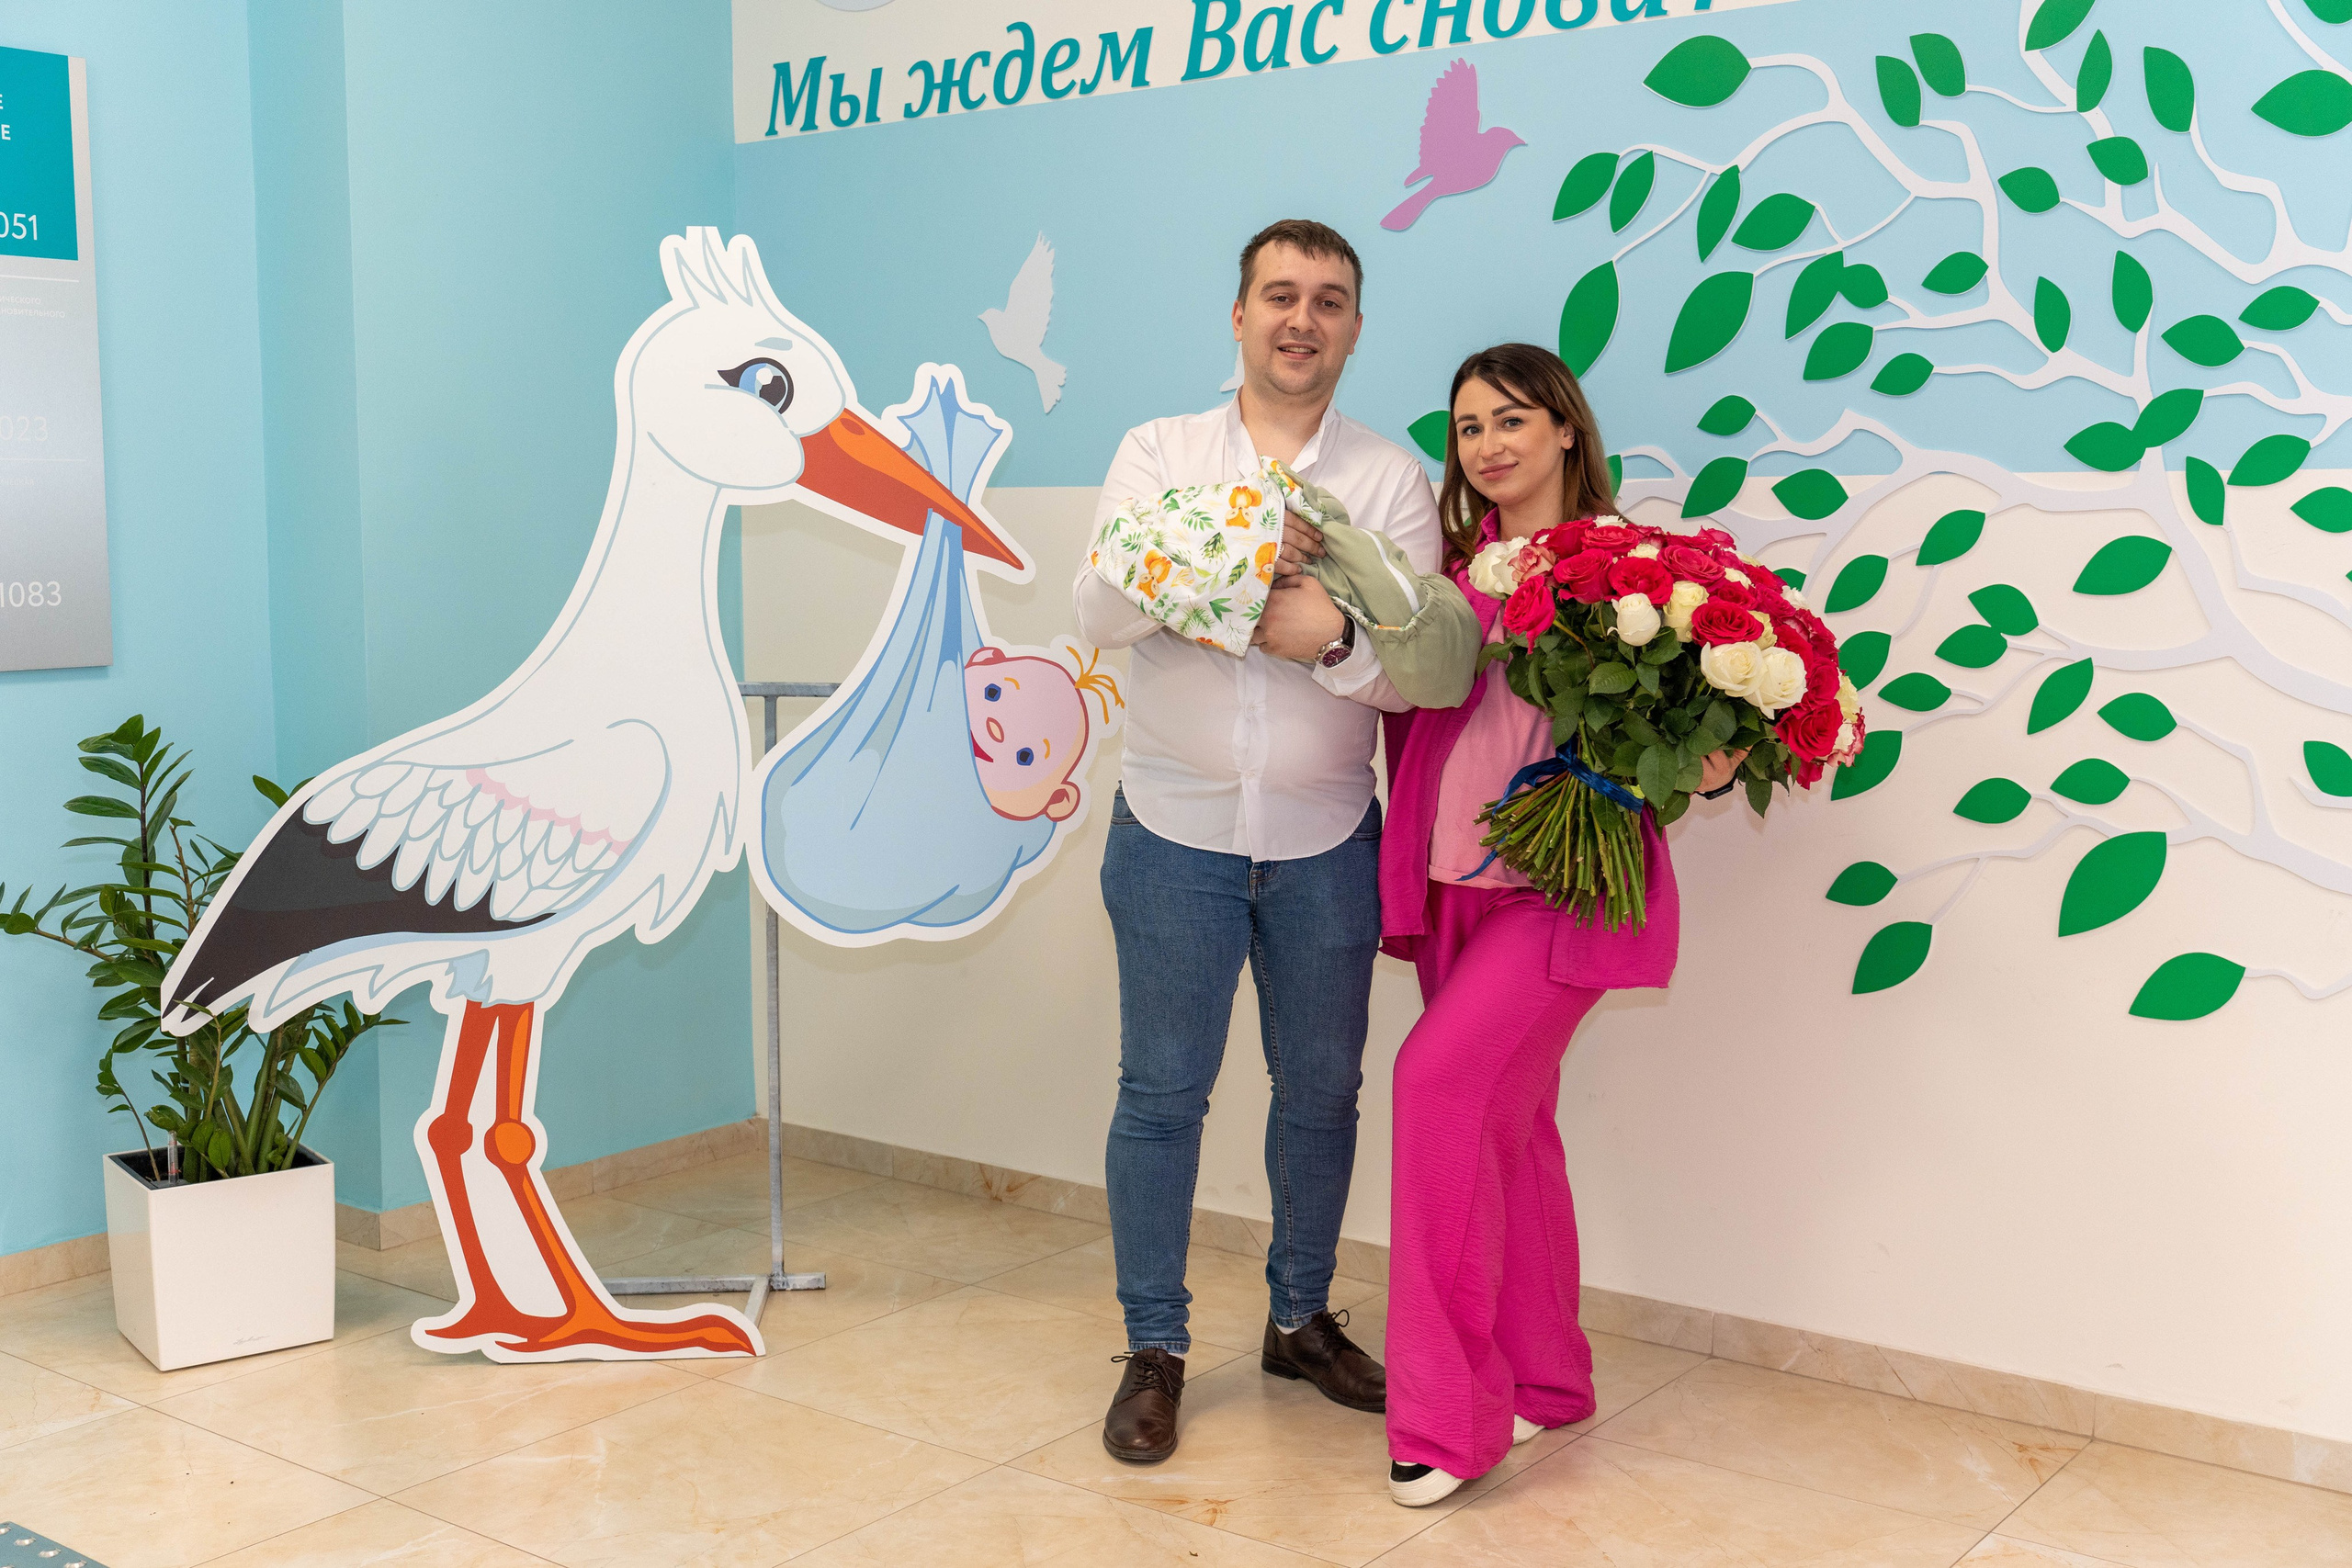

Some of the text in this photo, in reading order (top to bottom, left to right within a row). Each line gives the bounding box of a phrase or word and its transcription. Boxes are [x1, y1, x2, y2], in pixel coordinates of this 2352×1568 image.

[764, 55, 883, 137] Мы
[903, 21, 1154, 118] ждем
[1181, 0, 1345, 82] Вас
